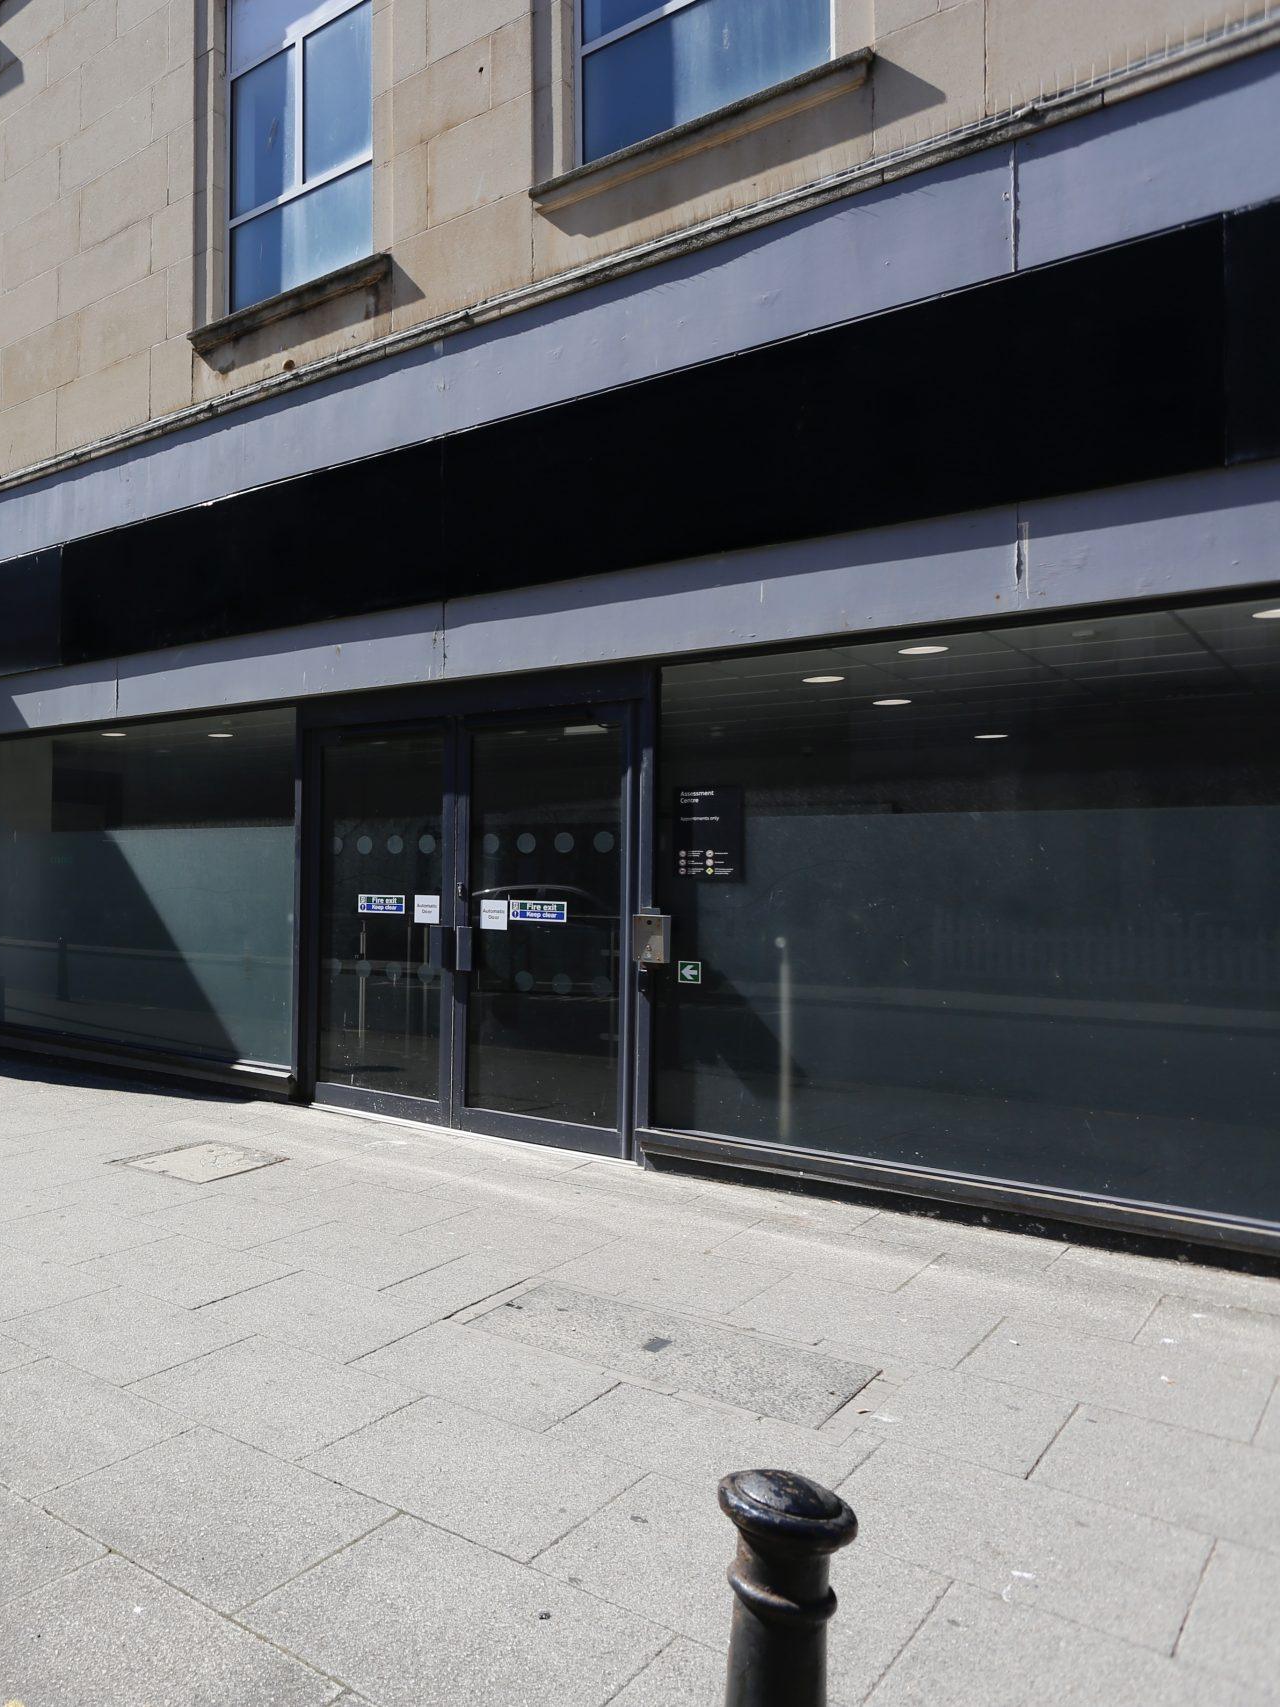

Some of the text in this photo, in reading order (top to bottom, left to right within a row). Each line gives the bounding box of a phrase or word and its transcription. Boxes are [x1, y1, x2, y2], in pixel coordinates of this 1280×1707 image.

[371, 896, 385, 904] Fire
[526, 903, 542, 911] Fire
[526, 911, 541, 919] Keep
